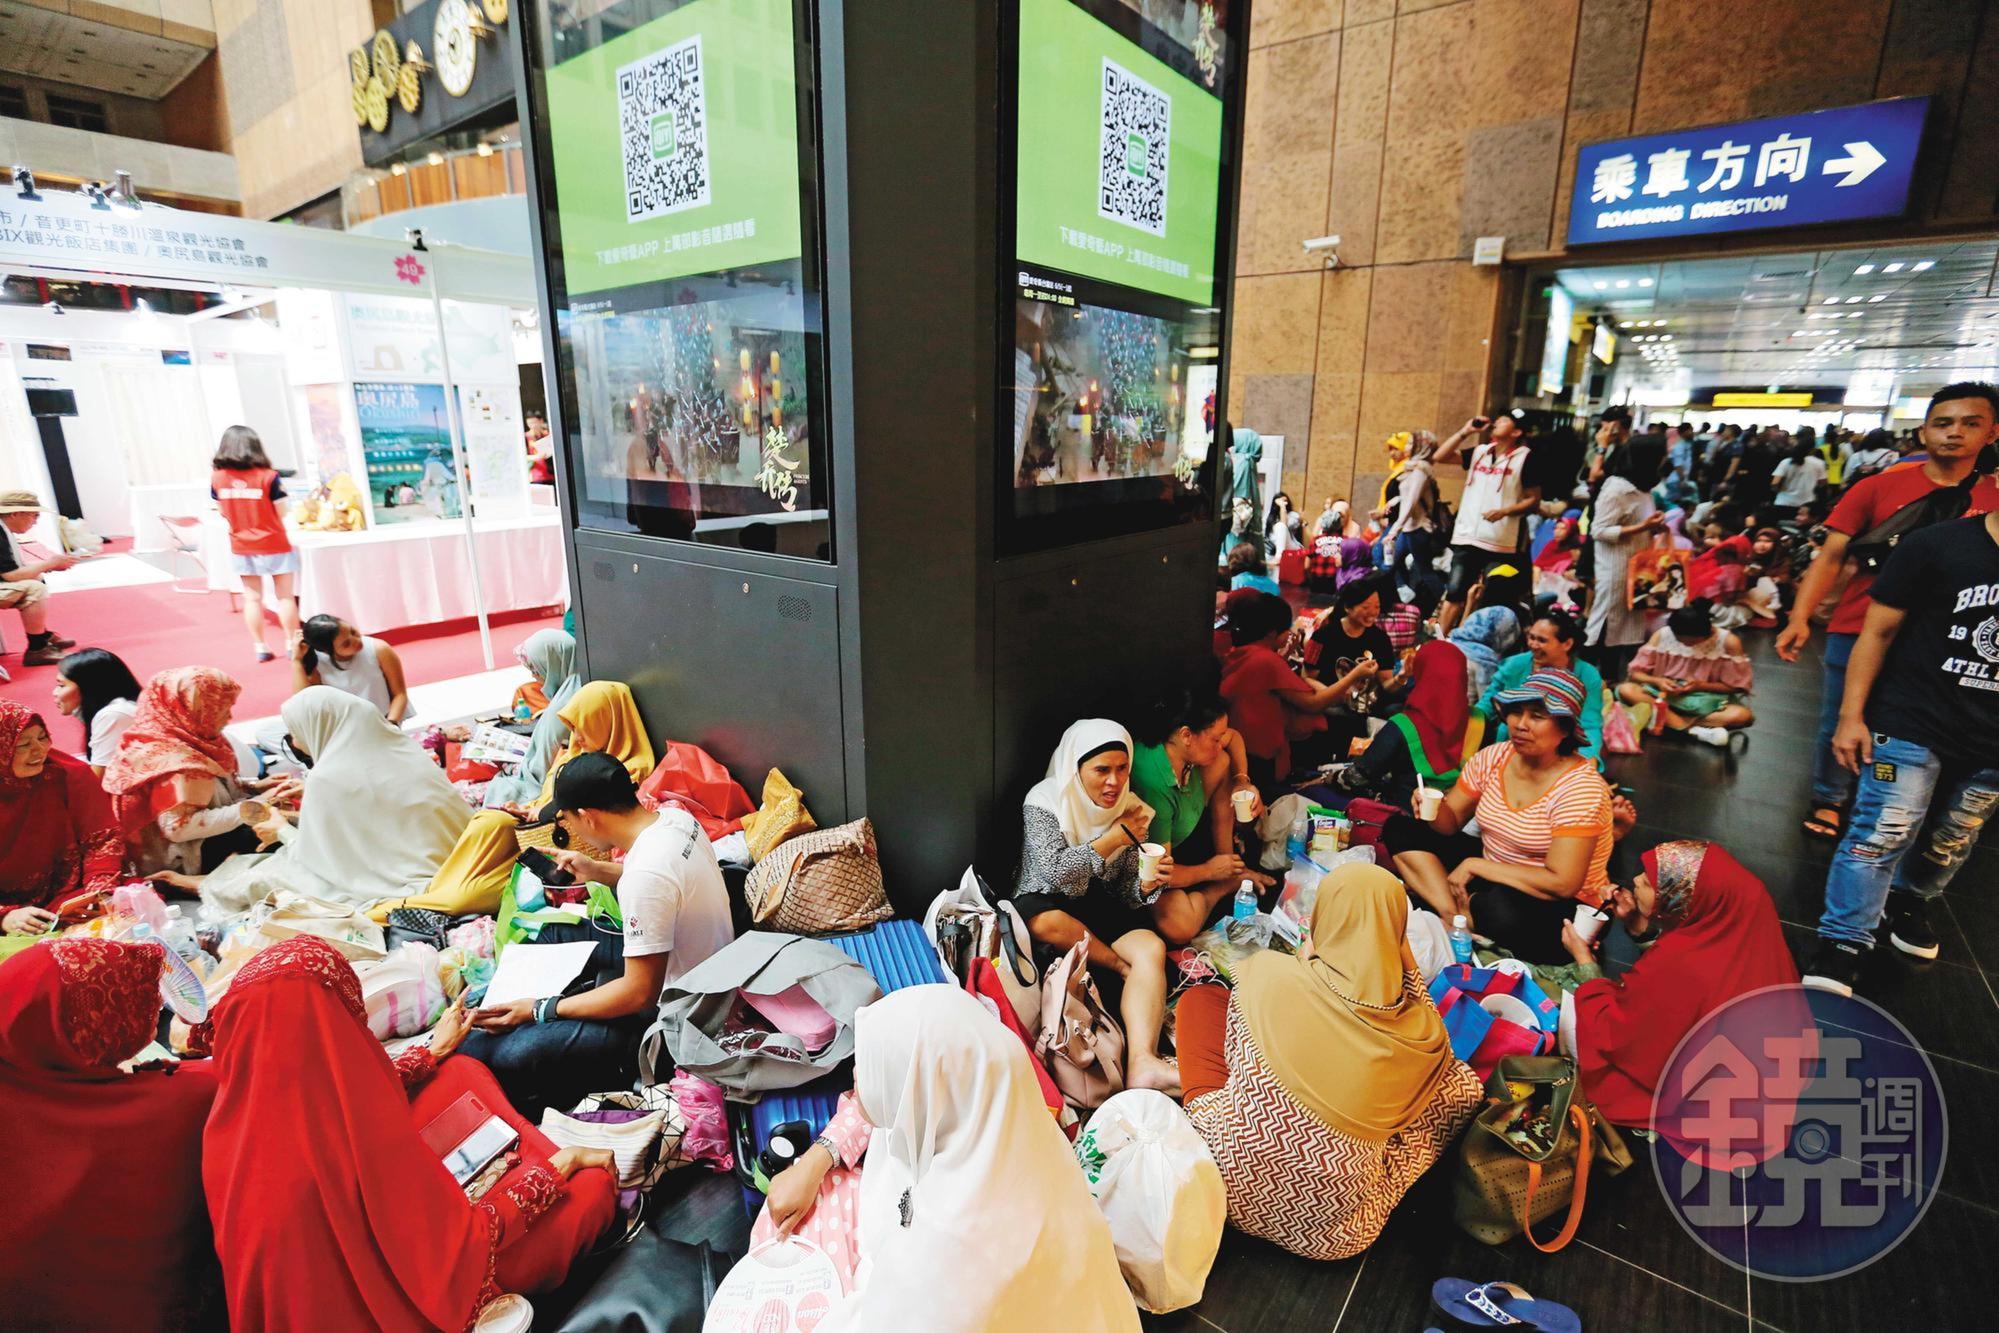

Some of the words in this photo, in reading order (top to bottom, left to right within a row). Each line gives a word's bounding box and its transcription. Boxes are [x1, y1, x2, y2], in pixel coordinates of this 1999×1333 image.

[1591, 132, 1812, 204] 乘車方向
[1596, 204, 1685, 229] BOARDING
[1689, 194, 1789, 220] DIRECTION
[401, 262, 419, 277] 49
[1314, 535, 1344, 547] CHICAG
[1947, 624, 1968, 641] 19
[1941, 657, 1990, 679] ATHL
